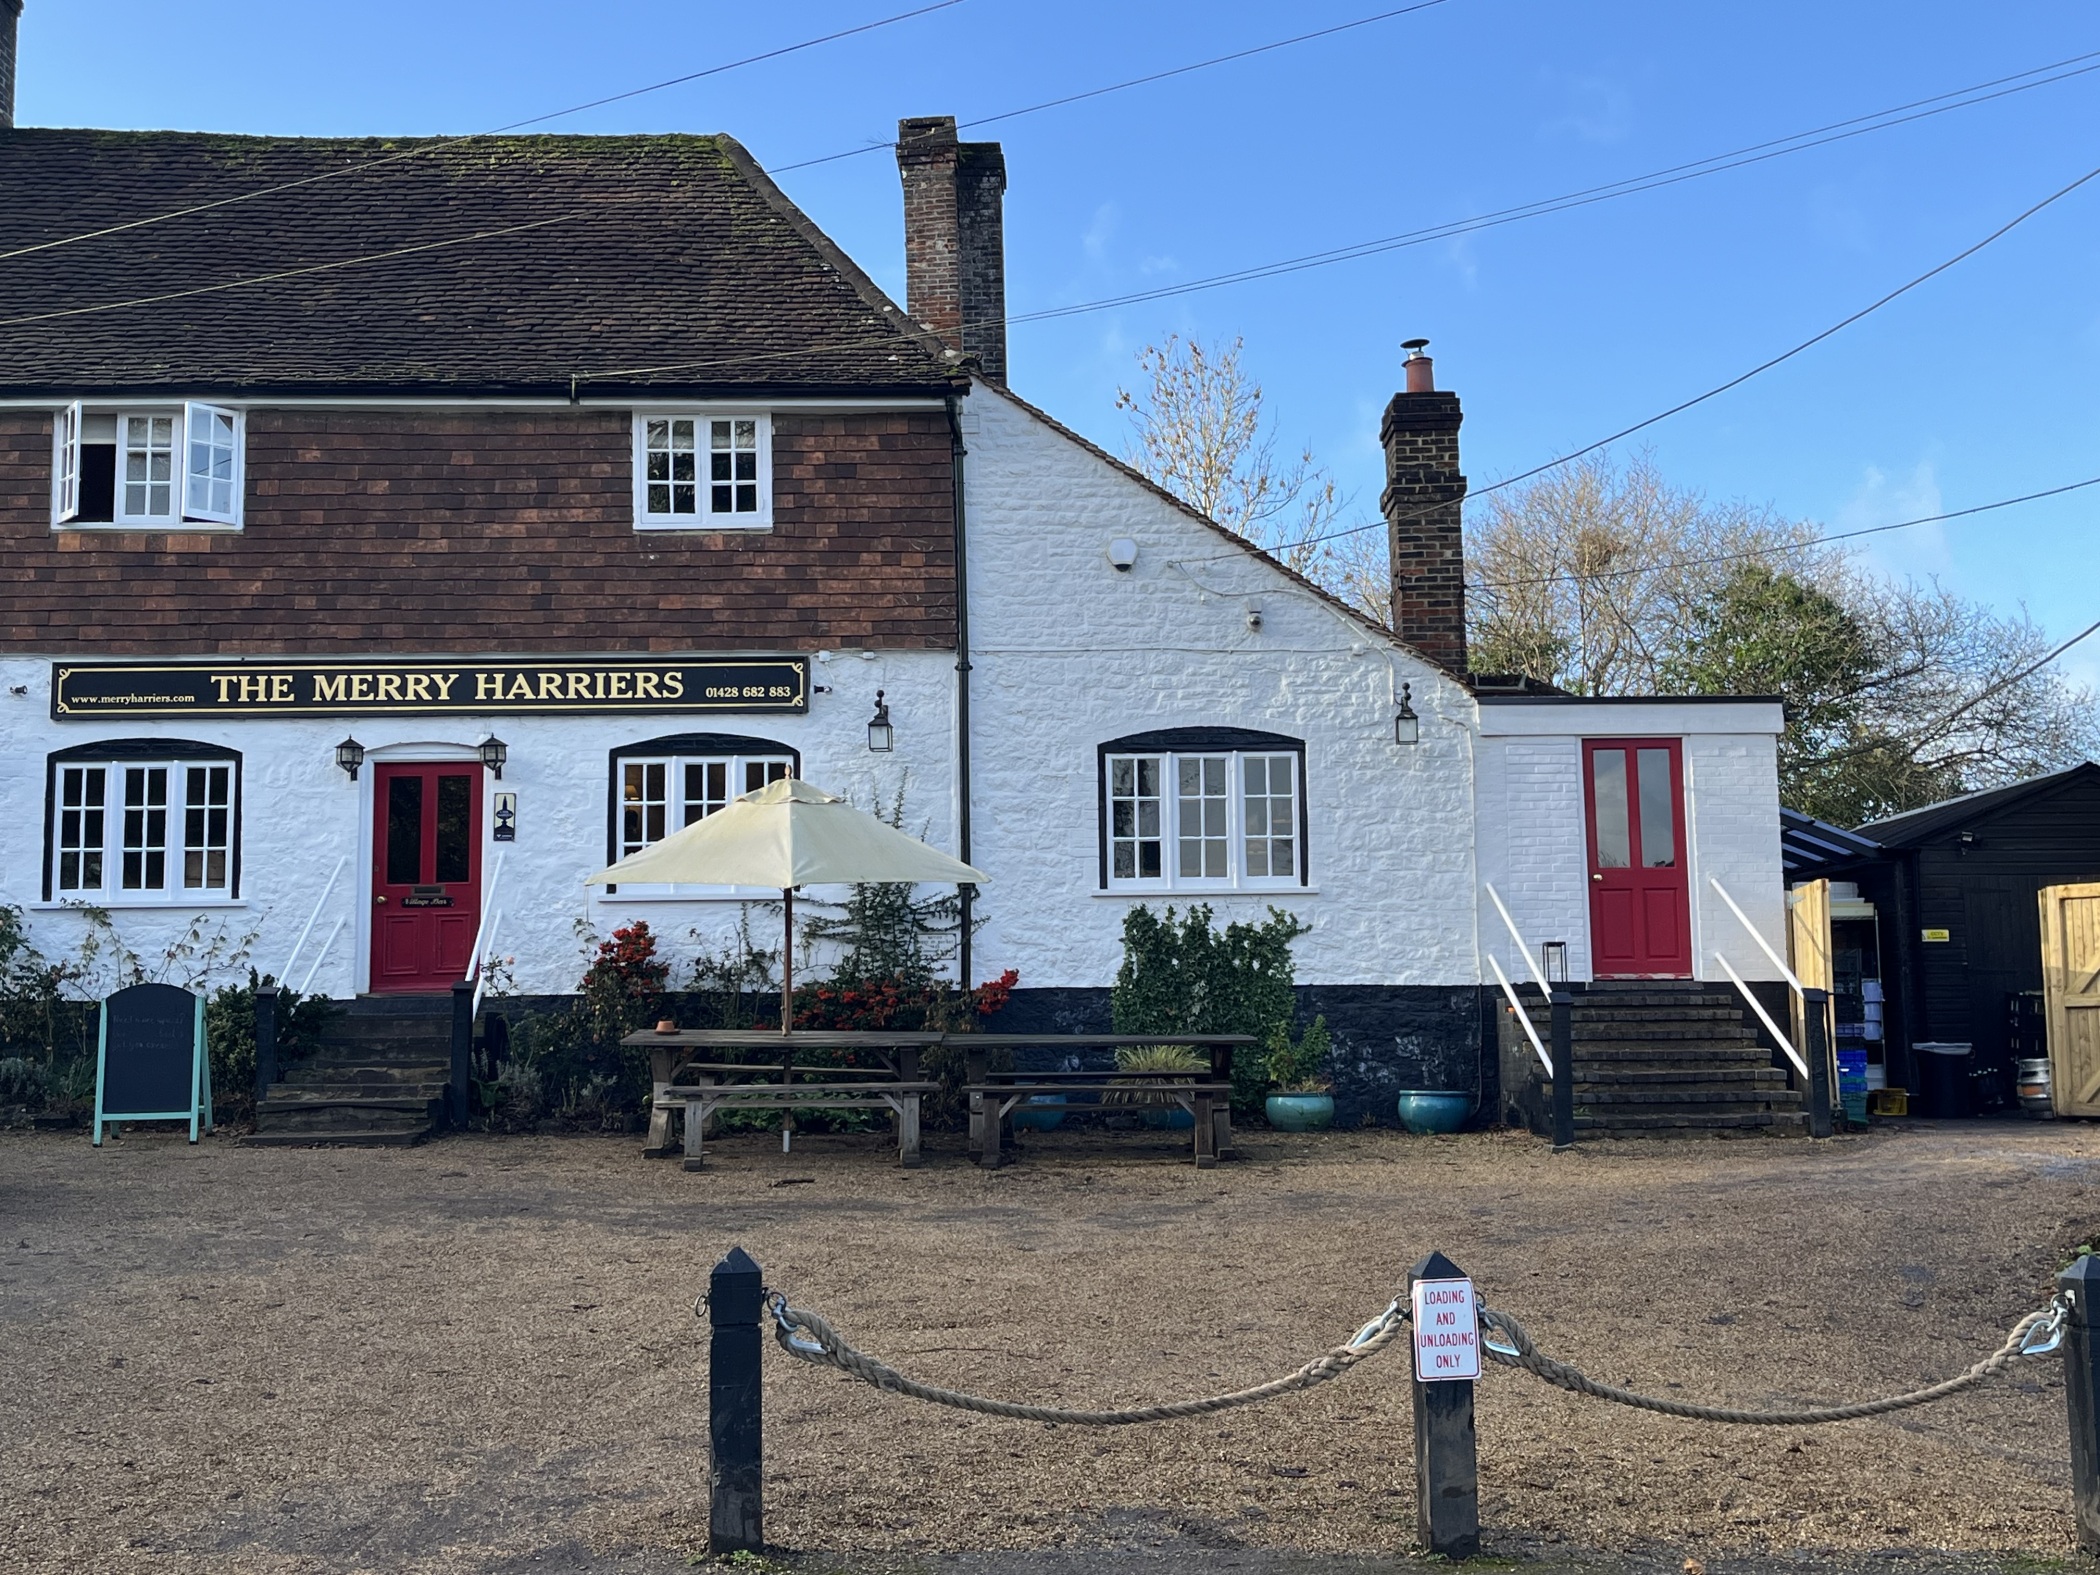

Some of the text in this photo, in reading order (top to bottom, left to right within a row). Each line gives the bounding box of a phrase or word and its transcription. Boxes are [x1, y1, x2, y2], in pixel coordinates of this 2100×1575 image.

[211, 672, 683, 702] THE MERRY HARRIERS
[706, 687, 790, 697] 01428 682 883
[71, 693, 194, 704] www.merryharriers.com
[1425, 1290, 1464, 1304] LOADING
[1436, 1312, 1455, 1325] AND
[1420, 1332, 1473, 1347] UNLOADING
[1436, 1355, 1460, 1368] ONLY
